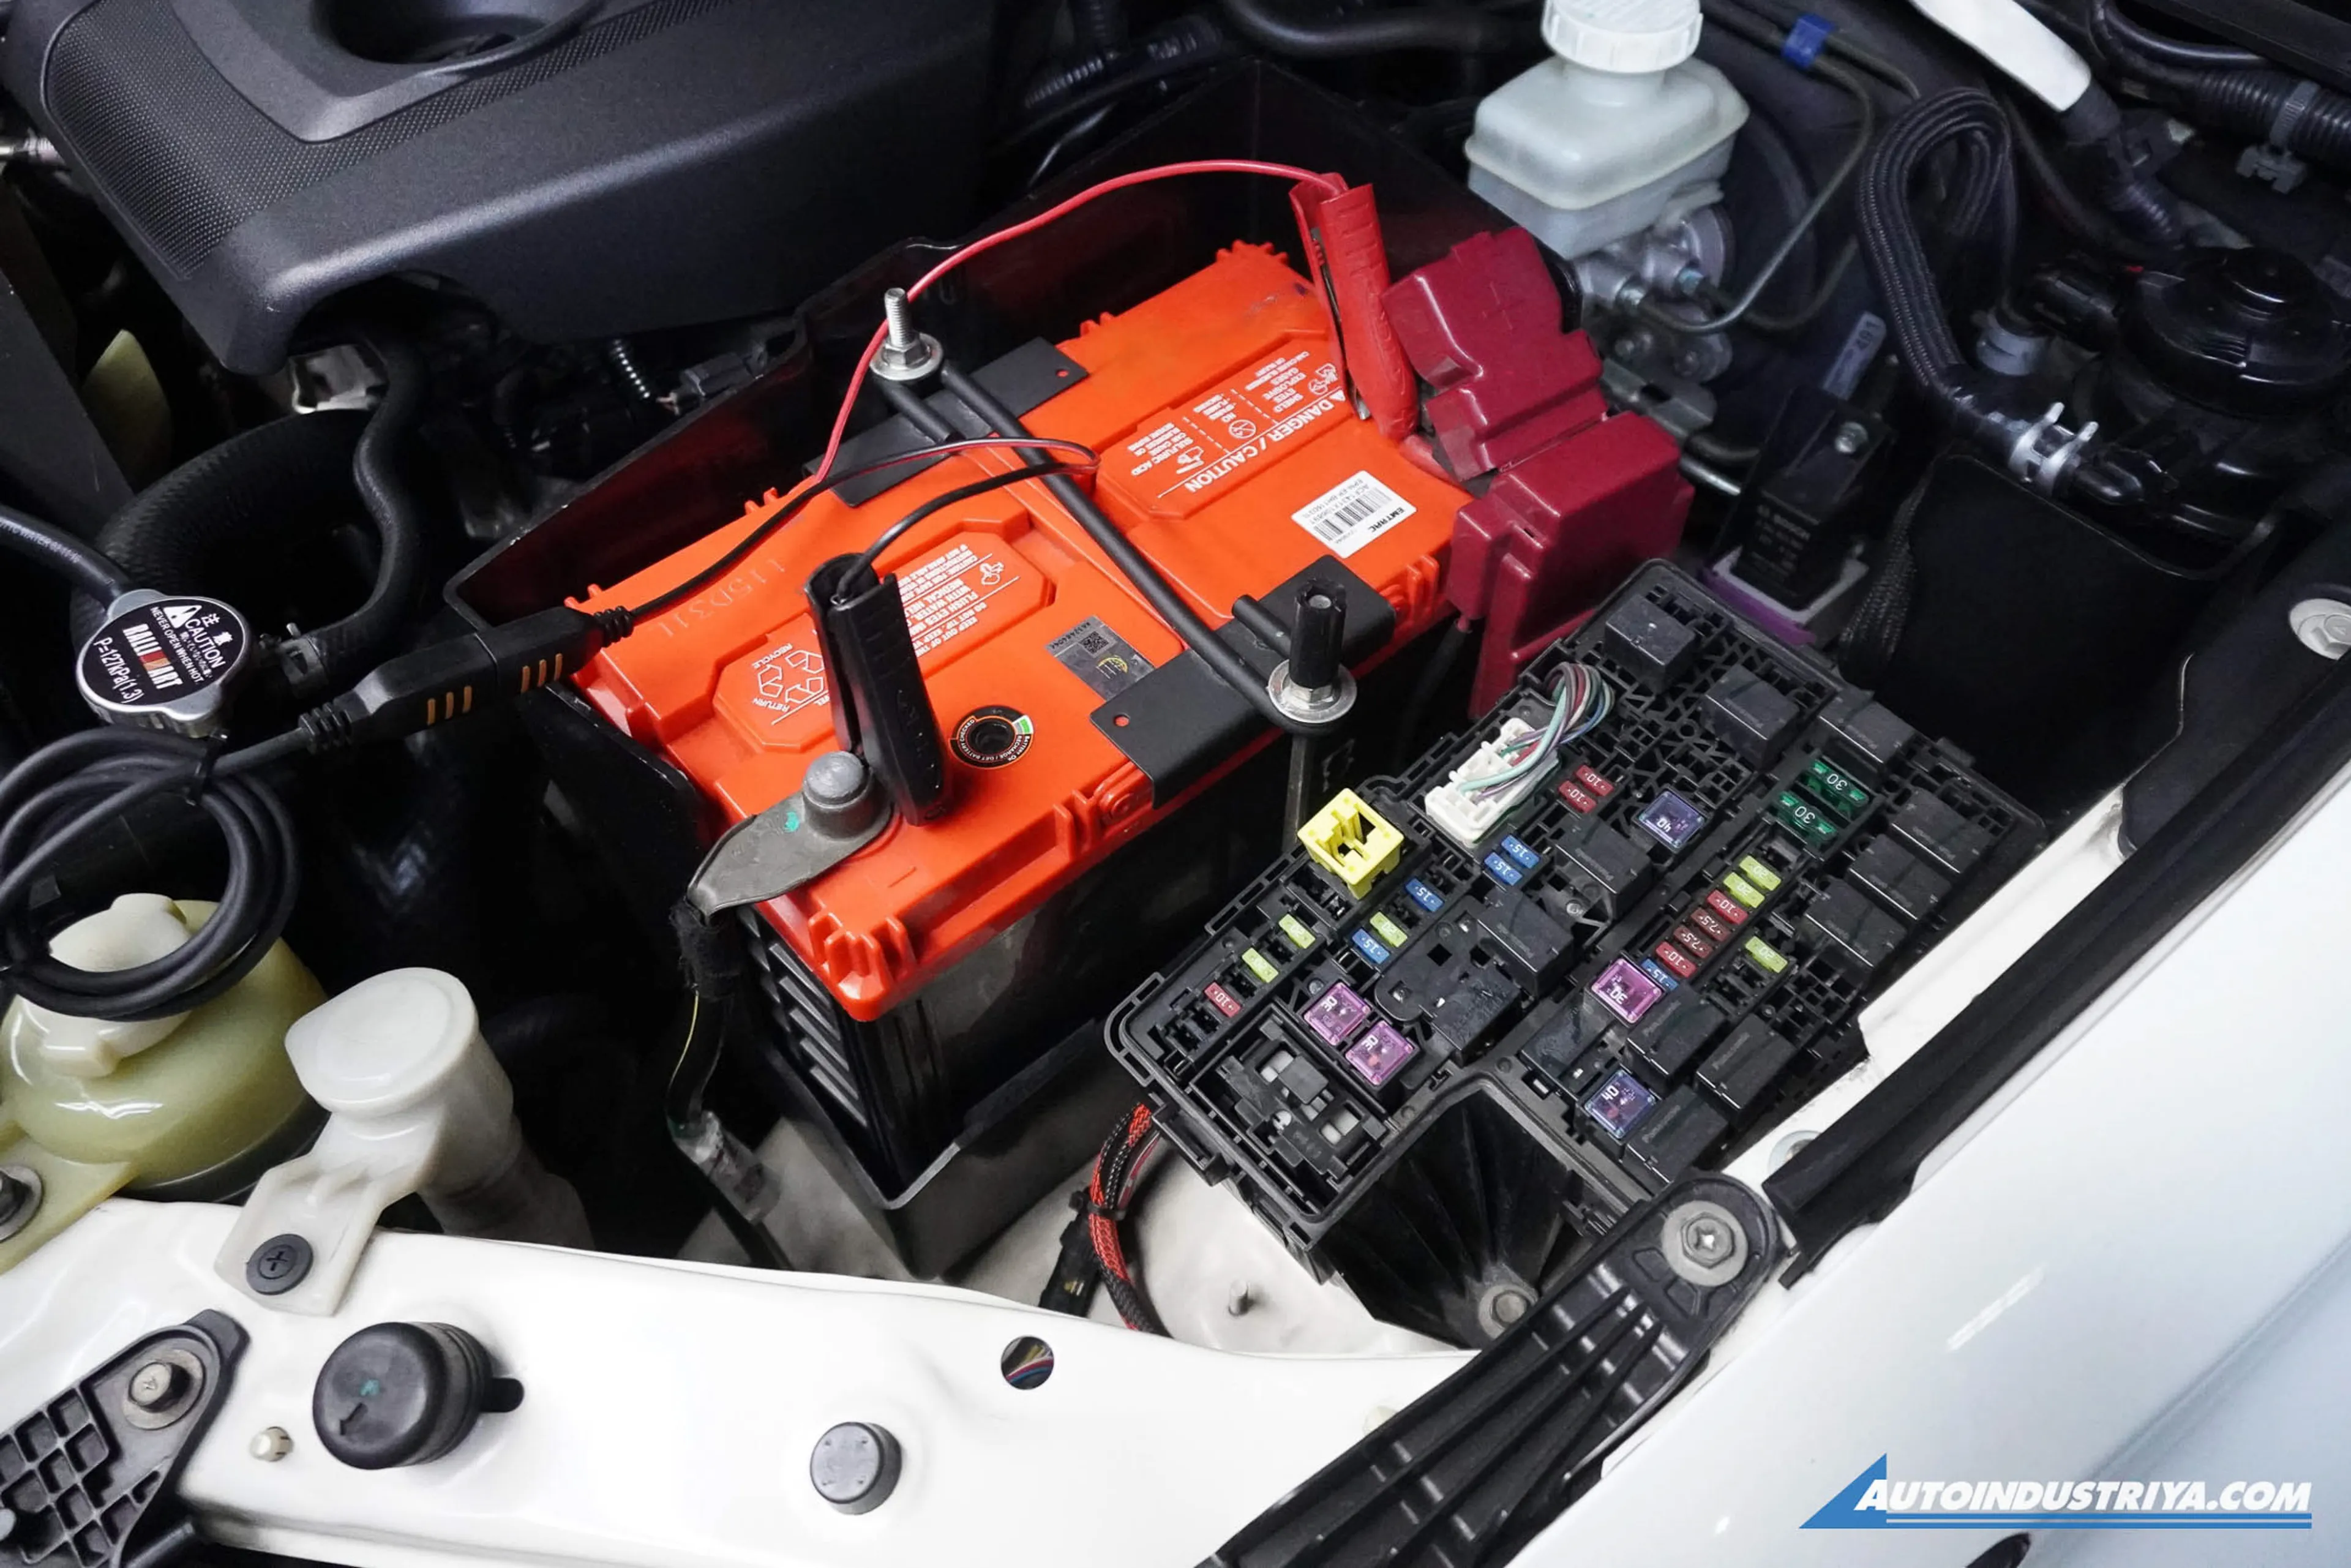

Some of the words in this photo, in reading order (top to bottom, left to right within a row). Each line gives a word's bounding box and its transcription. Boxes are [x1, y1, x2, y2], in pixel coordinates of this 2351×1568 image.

[1261, 372, 1305, 400] EXPLOSIVE
[1272, 393, 1303, 413] SHIELD
[1267, 398, 1333, 441] DANGER
[1151, 437, 1193, 463] SULFURIC
[1130, 461, 1153, 476] ACID
[1183, 445, 1259, 492] CAUTION
[1367, 507, 1404, 533] EMTRAC
[922, 577, 964, 604] MEDICAL
[945, 584, 970, 602] WITH
[947, 591, 978, 612] FLUSH
[972, 601, 988, 613] DO
[923, 608, 949, 626] EYES
[956, 608, 975, 623] NOT
[957, 615, 978, 631] KEEP
[149, 606, 171, 630] NEVER
[163, 628, 182, 649] OPEN
[175, 647, 195, 668] WHEN
[921, 627, 943, 642] KEEP
[940, 628, 958, 640] OUT
[184, 618, 225, 669] CAUTION
[928, 637, 942, 648] OF
[751, 642, 792, 669] RECYCLE
[751, 697, 789, 711] RETURN
[959, 719, 975, 741] CHECKED
[961, 743, 981, 759] BATTERY
[1000, 735, 1021, 758] RECHARGE
[1587, 773, 1602, 786] 10
[1826, 773, 1847, 790] 30
[1570, 789, 1586, 802] 10
[1794, 806, 1815, 823] 30
[1514, 843, 1527, 857] 15
[1496, 860, 1510, 874] 15
[1419, 887, 1431, 901] 15
[1738, 882, 1752, 894] 20
[1721, 900, 1736, 913] 10
[1701, 917, 1718, 931] 7.5
[1364, 939, 1378, 953] 15
[1684, 933, 1701, 948] 7.5
[1669, 951, 1682, 966] 10
[1653, 969, 1667, 982] 15
[1215, 992, 1230, 1006] 10
[1320, 997, 1338, 1011] 30
[1610, 989, 1627, 1004] 30
[1361, 1035, 1378, 1050] 30
[1601, 1086, 1619, 1100] 40
